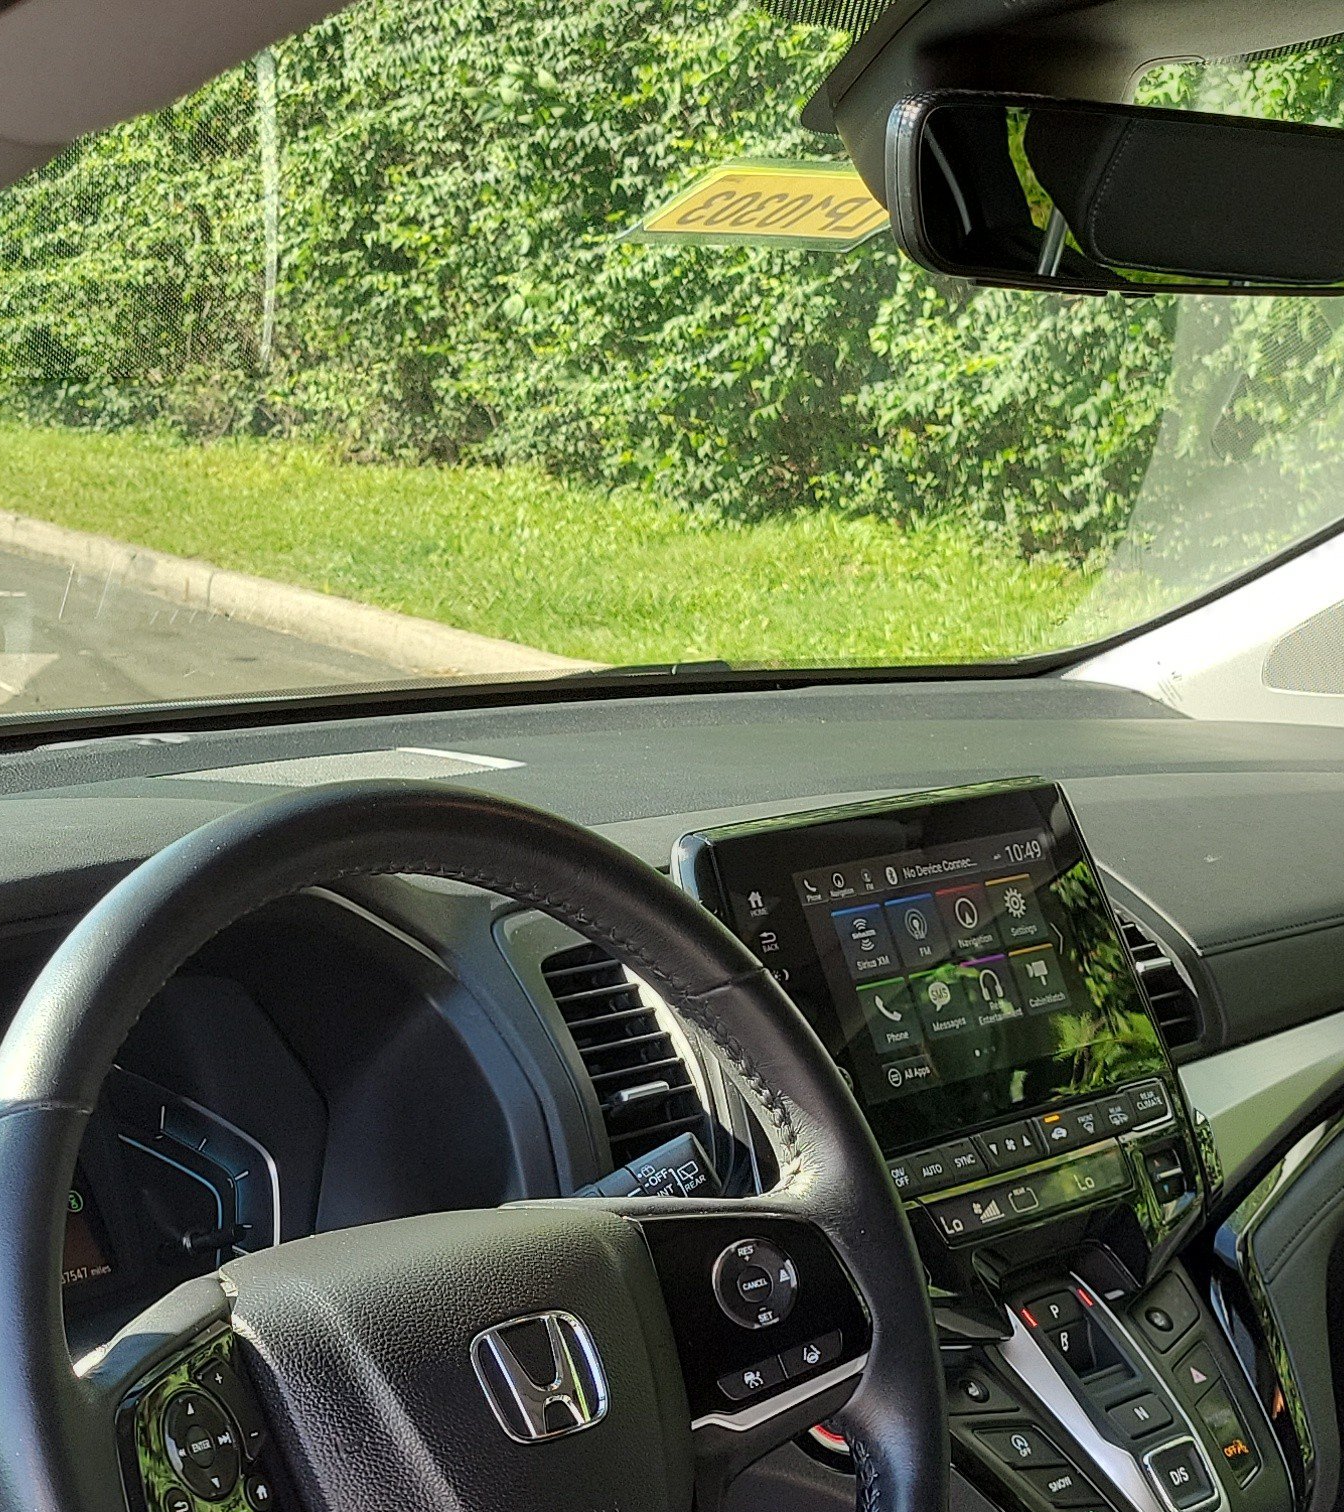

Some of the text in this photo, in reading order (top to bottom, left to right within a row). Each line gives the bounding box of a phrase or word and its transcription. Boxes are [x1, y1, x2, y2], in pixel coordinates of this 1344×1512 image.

[1005, 840, 1043, 862] 10:49
[903, 867, 914, 879] No
[917, 863, 943, 877] Device
[1011, 924, 1037, 937] Settings
[762, 943, 780, 953] BACK
[958, 933, 993, 949] Navigation
[919, 946, 932, 957] FM
[856, 955, 891, 971] Sirius XM
[931, 987, 949, 1001] SMS
[932, 1017, 966, 1032] Messages
[886, 1031, 909, 1043] Phone
[904, 1066, 931, 1080] All Apps
[954, 1153, 976, 1168] SYNC
[922, 1163, 943, 1177] AUTO
[684, 1174, 706, 1192] REAR
[895, 1175, 910, 1188] OFF
[1074, 1174, 1095, 1192] Lo
[940, 1216, 964, 1235] Lo
[737, 1245, 754, 1257] RES
[742, 1278, 768, 1291] CANCEL
[758, 1310, 773, 1323] SET
[1050, 1305, 1059, 1318] P
[1133, 1406, 1150, 1421] N
[191, 1439, 211, 1454] ENTER
[1048, 1475, 1072, 1492] SNOW
[1169, 1466, 1190, 1486] D/S
